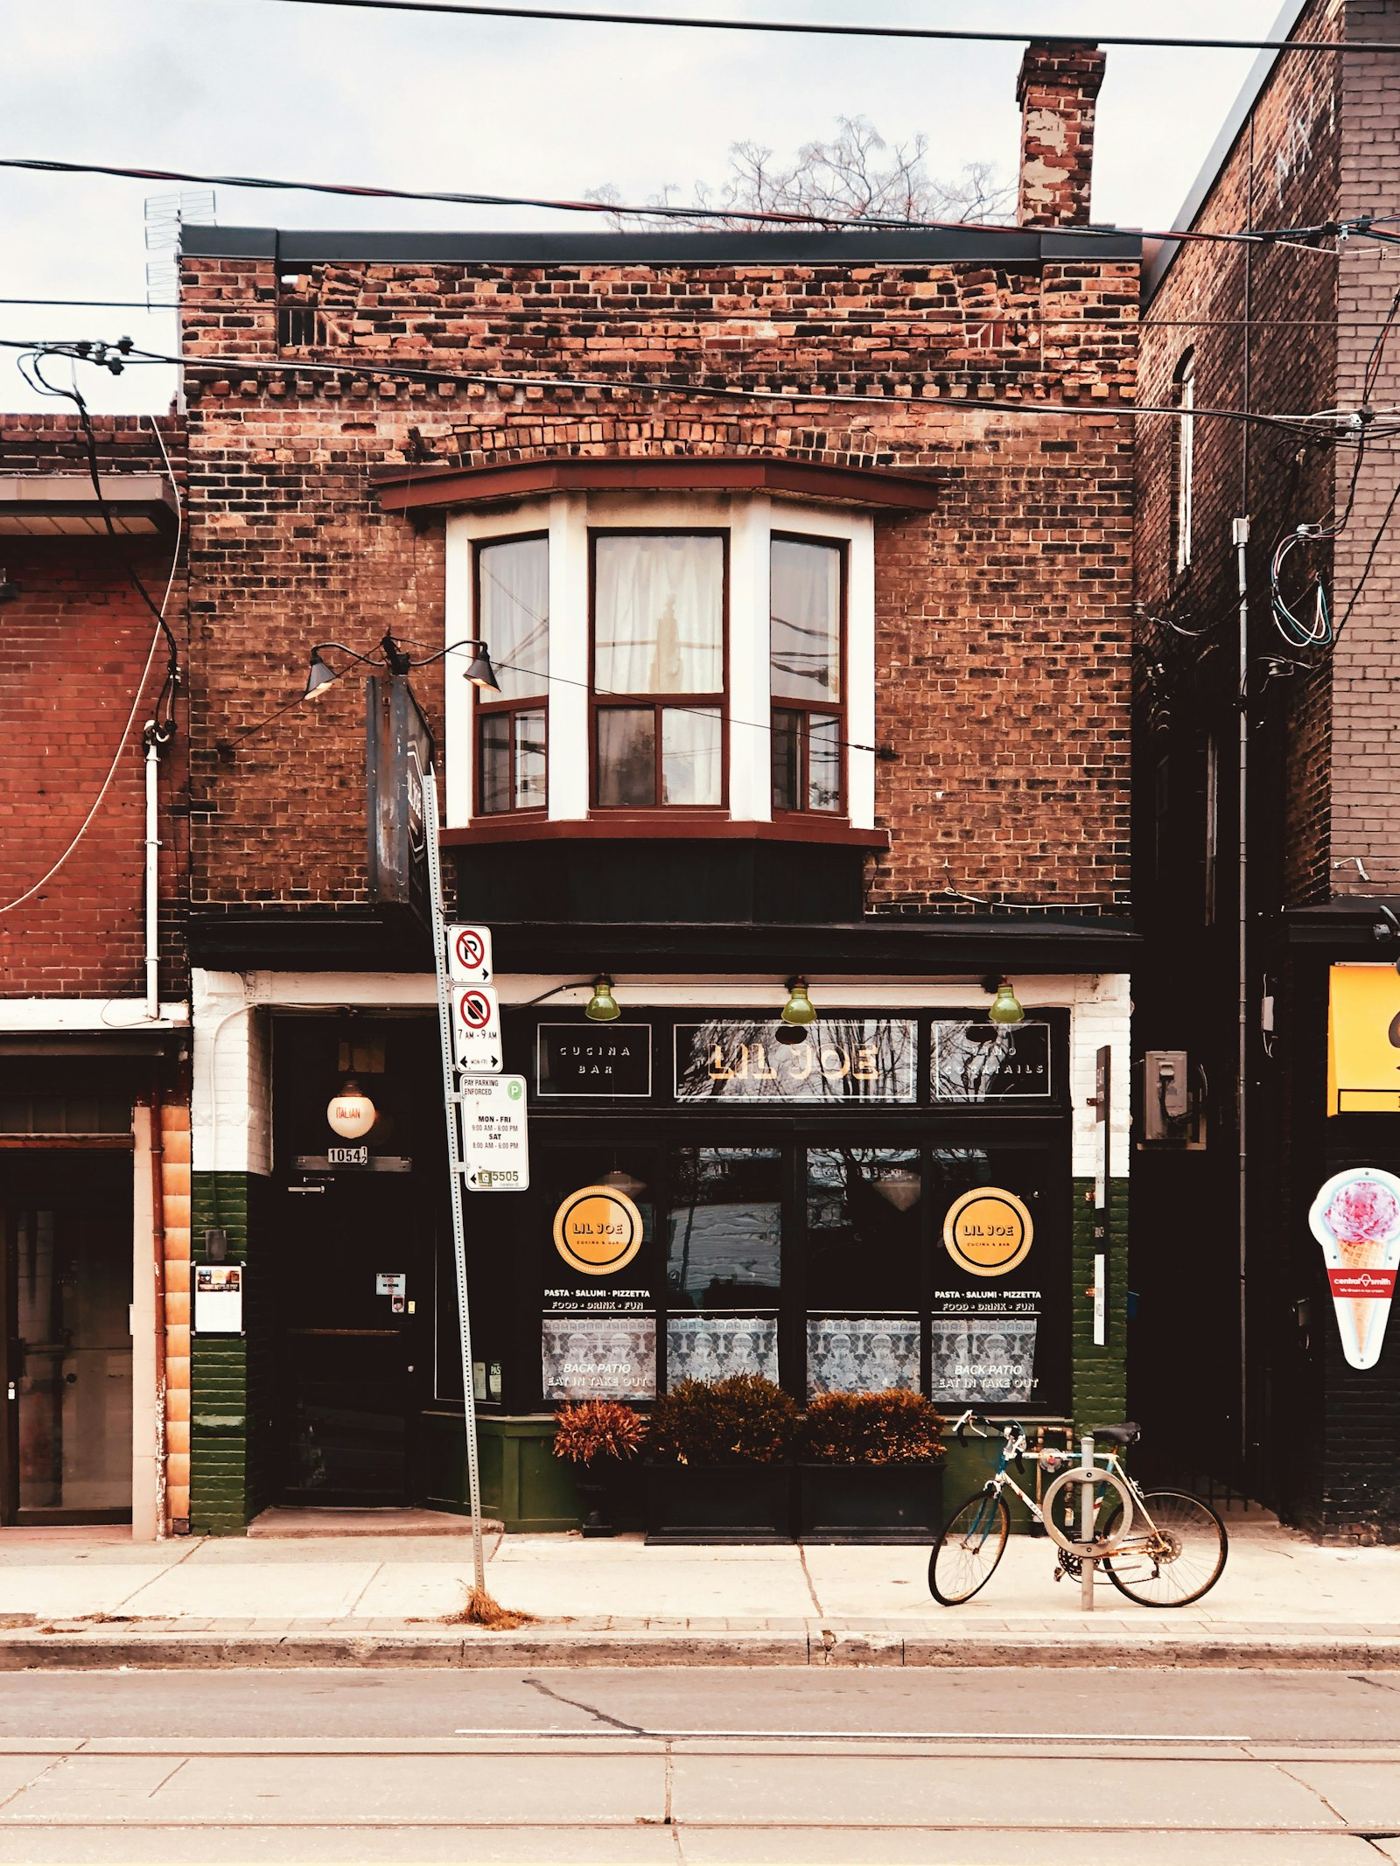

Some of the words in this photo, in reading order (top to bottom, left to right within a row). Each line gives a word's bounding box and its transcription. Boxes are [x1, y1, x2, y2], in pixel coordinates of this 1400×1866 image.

[457, 1029, 463, 1039] 7
[465, 1031, 474, 1039] AM
[481, 1029, 486, 1039] 9
[488, 1031, 497, 1039] AM
[560, 1047, 630, 1056] CUCINA
[708, 1043, 777, 1080] LIL
[788, 1043, 880, 1080] JOE
[578, 1065, 613, 1074] BAR
[336, 1107, 361, 1119] ITALIAN
[330, 1149, 360, 1161] 1054
[492, 1171, 519, 1181] 5505
[573, 1223, 594, 1235] LIL
[596, 1223, 623, 1235] JOE
[964, 1225, 985, 1236] LIL
[987, 1225, 1014, 1236] JOE
[544, 1289, 570, 1297] PASTA
[575, 1289, 606, 1297] SALUMI
[612, 1290, 651, 1298] PIZZETTA
[934, 1291, 960, 1299] PASTA
[965, 1291, 997, 1299] SALUMI
[1003, 1291, 1041, 1299] PIZZETTA
[552, 1301, 578, 1309] FOOD
[586, 1301, 616, 1309] DRINK
[624, 1301, 644, 1309] FUN
[942, 1303, 969, 1311] FOOD
[977, 1303, 1007, 1311] DRINK
[1015, 1303, 1035, 1311] FUN
[563, 1363, 595, 1373] BACK
[597, 1363, 631, 1373] PATIO
[954, 1365, 986, 1375] BACK
[988, 1365, 1023, 1375] PATIO
[548, 1376, 569, 1387] EAT
[573, 1376, 585, 1386] IN
[590, 1376, 618, 1386] TAKE
[623, 1376, 647, 1387] OUT
[938, 1378, 961, 1388] EAT
[964, 1378, 977, 1388] IN
[980, 1378, 1011, 1388] TAKE
[1013, 1378, 1039, 1388] OUT
